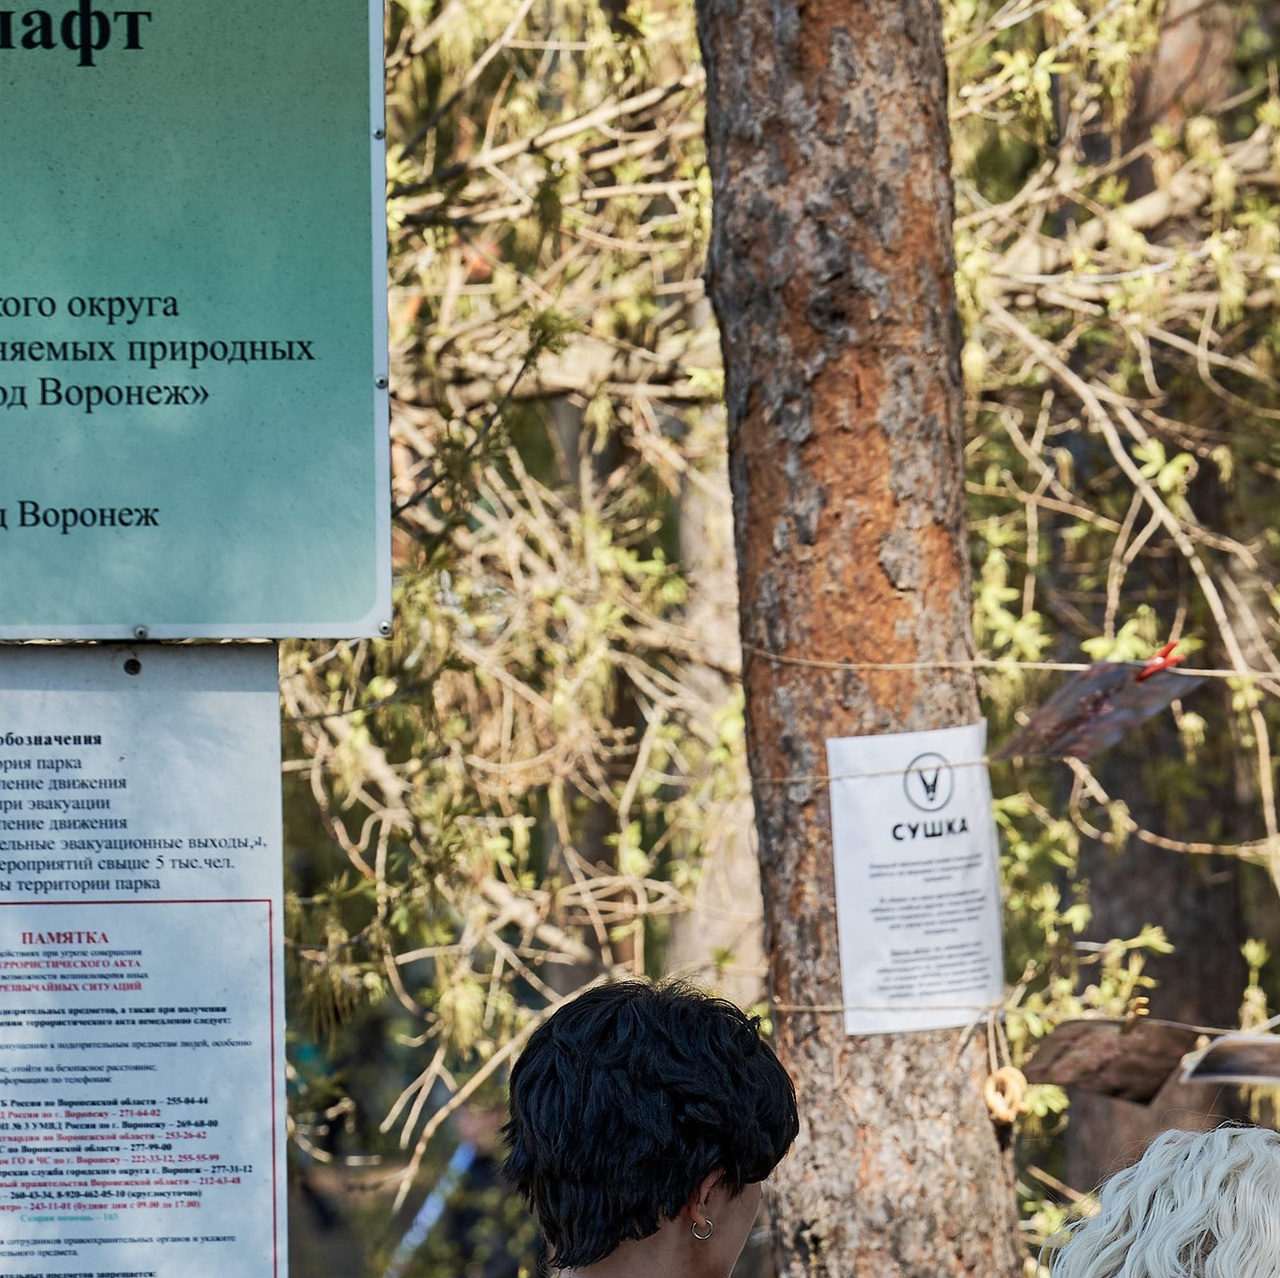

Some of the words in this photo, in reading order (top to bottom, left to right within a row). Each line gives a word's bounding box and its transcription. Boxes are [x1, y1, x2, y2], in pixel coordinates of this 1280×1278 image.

[0, 297, 57, 317] ого
[67, 297, 180, 325] округа
[128, 341, 315, 369] природных
[40, 378, 209, 413] Воронеж»
[18, 501, 159, 535] Воронеж
[37, 759, 82, 773] парка
[48, 778, 127, 791] движения
[28, 799, 110, 813] эвакуации
[48, 818, 127, 831] движения
[892, 817, 968, 841] СУШКА
[60, 839, 183, 853] эвакуационные
[97, 859, 151, 869] свыше
[156, 855, 165, 869] 5
[16, 880, 110, 894] территории
[115, 879, 161, 893] парка
[22, 932, 110, 944] ПАМЯТКА
